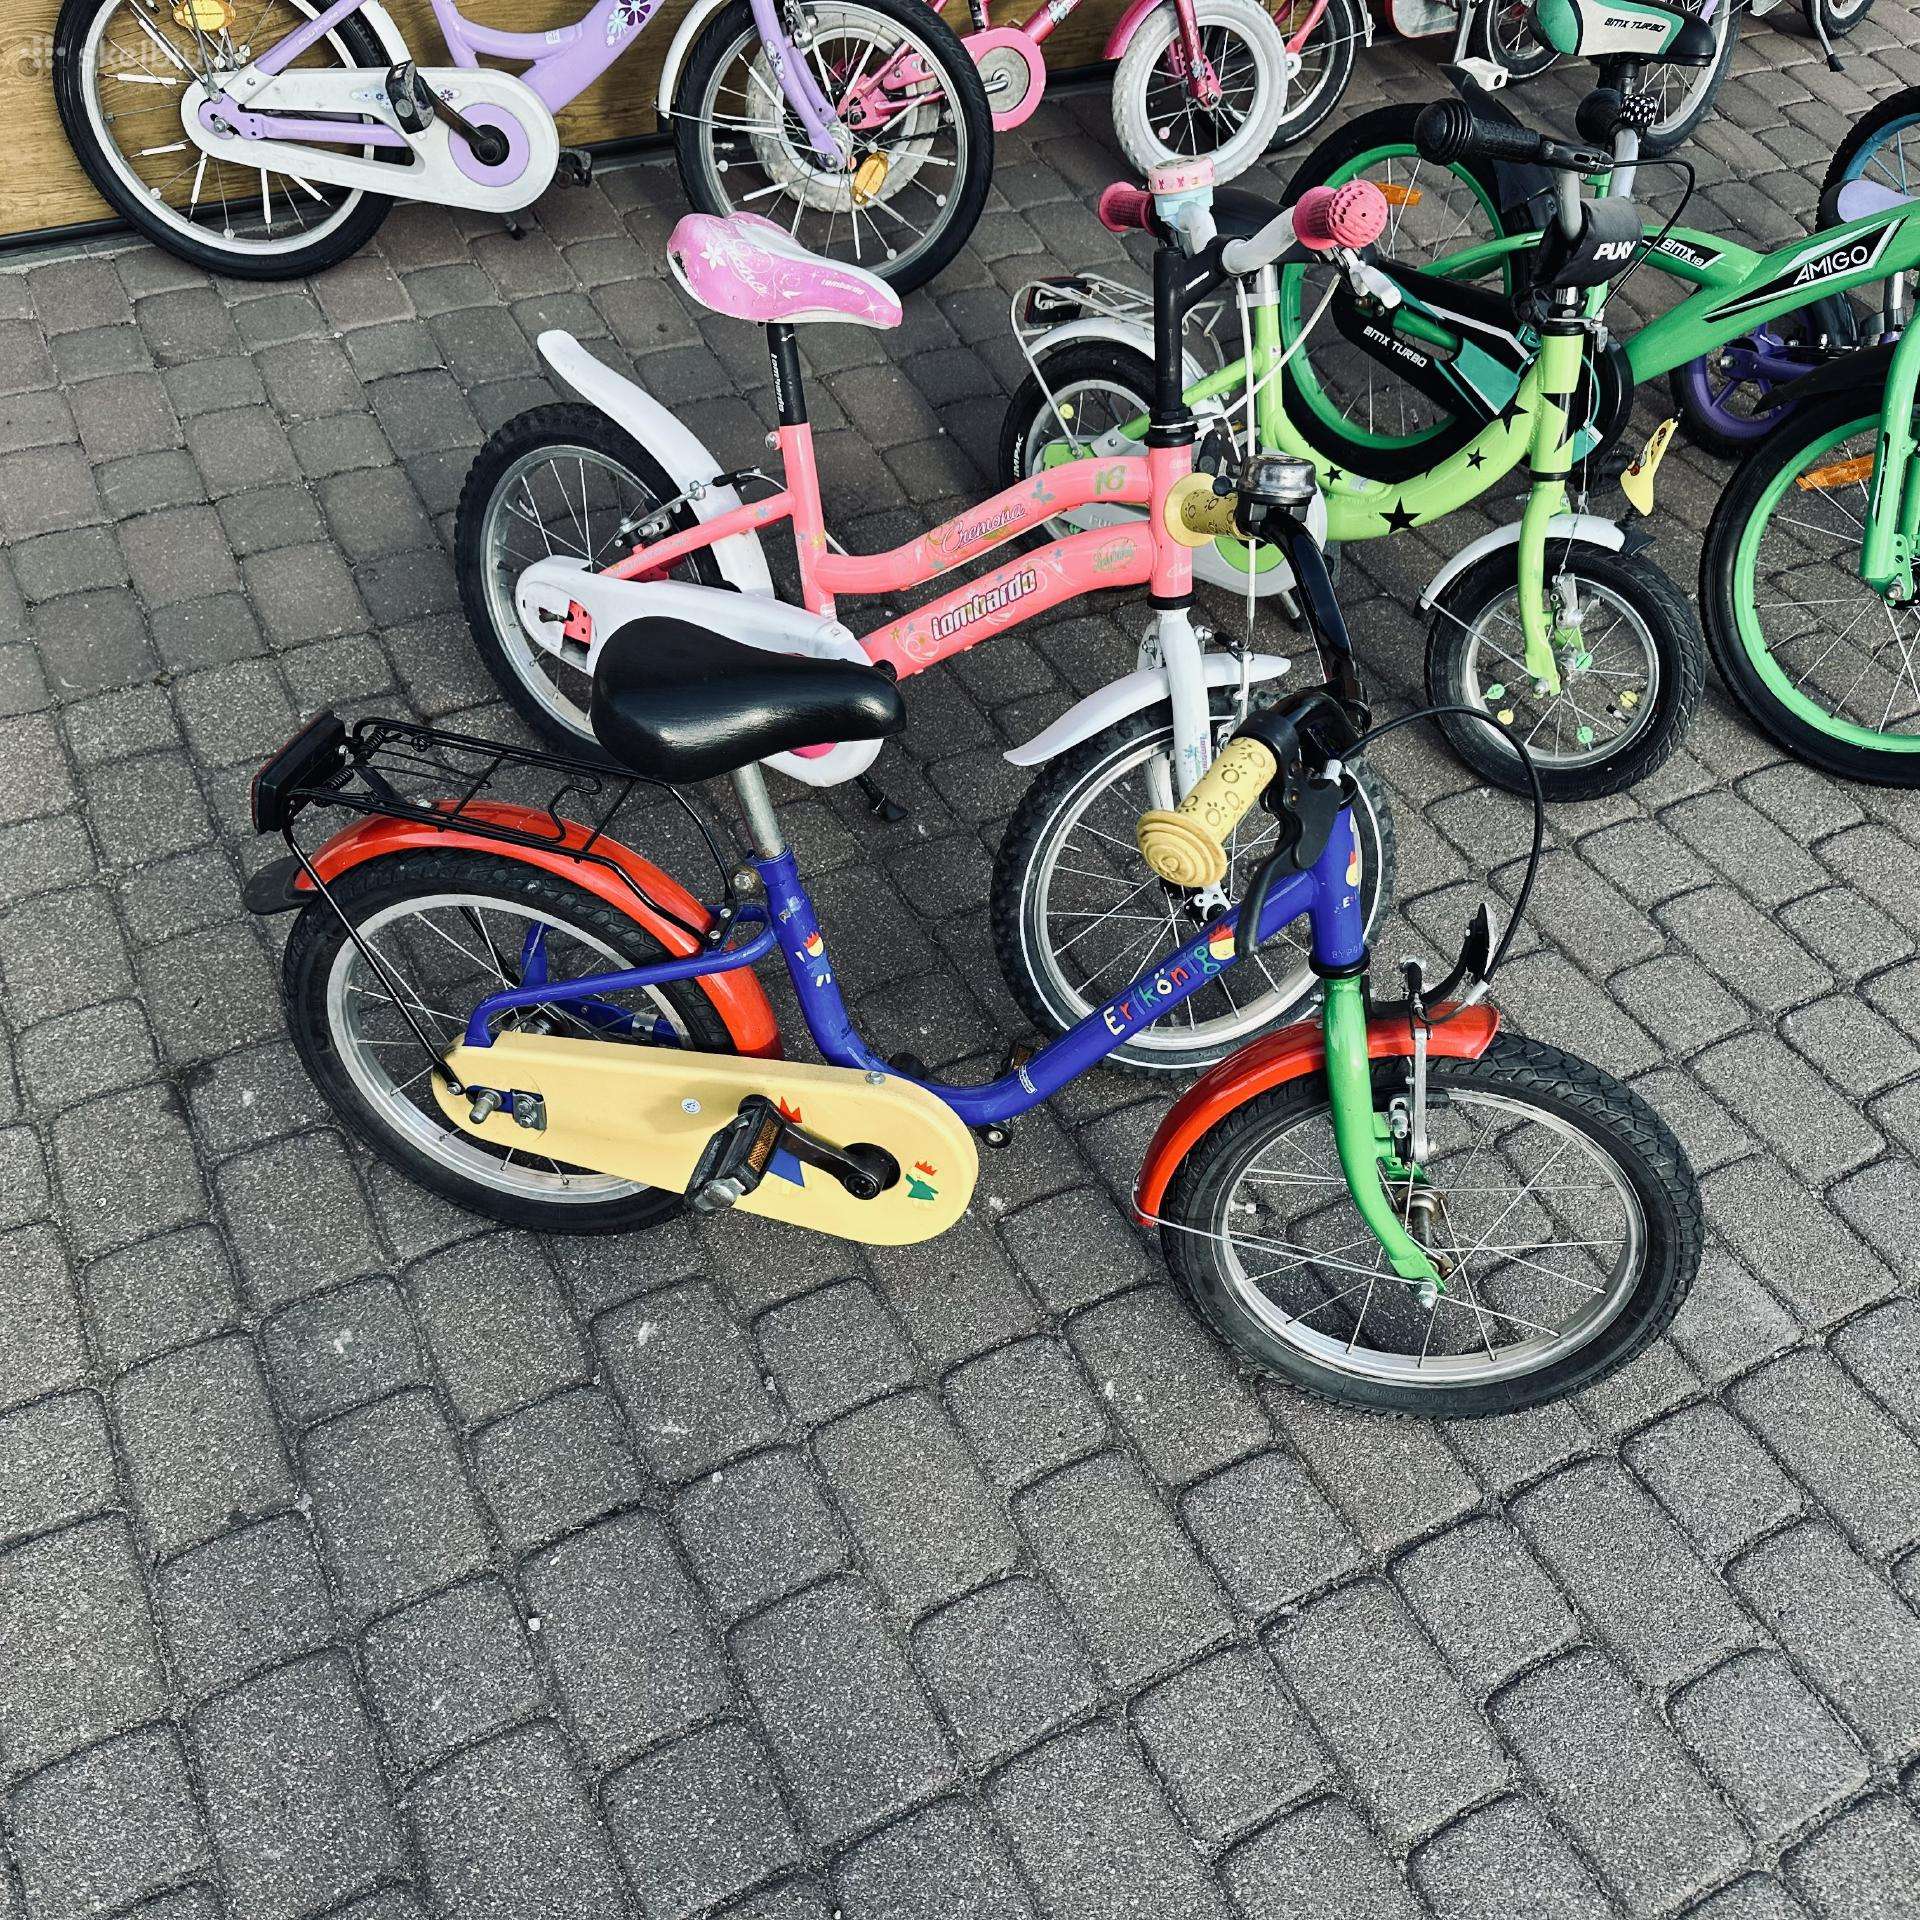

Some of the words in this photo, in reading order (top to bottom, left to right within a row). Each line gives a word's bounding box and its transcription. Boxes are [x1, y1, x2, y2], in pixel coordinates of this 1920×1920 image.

[1604, 17, 1630, 29] BMX
[1631, 21, 1666, 33] TURBO
[1793, 246, 1868, 285] AMIGO
[1363, 325, 1391, 347] BMX
[1392, 341, 1428, 368] TURBO
[941, 503, 1026, 553] Cremona
